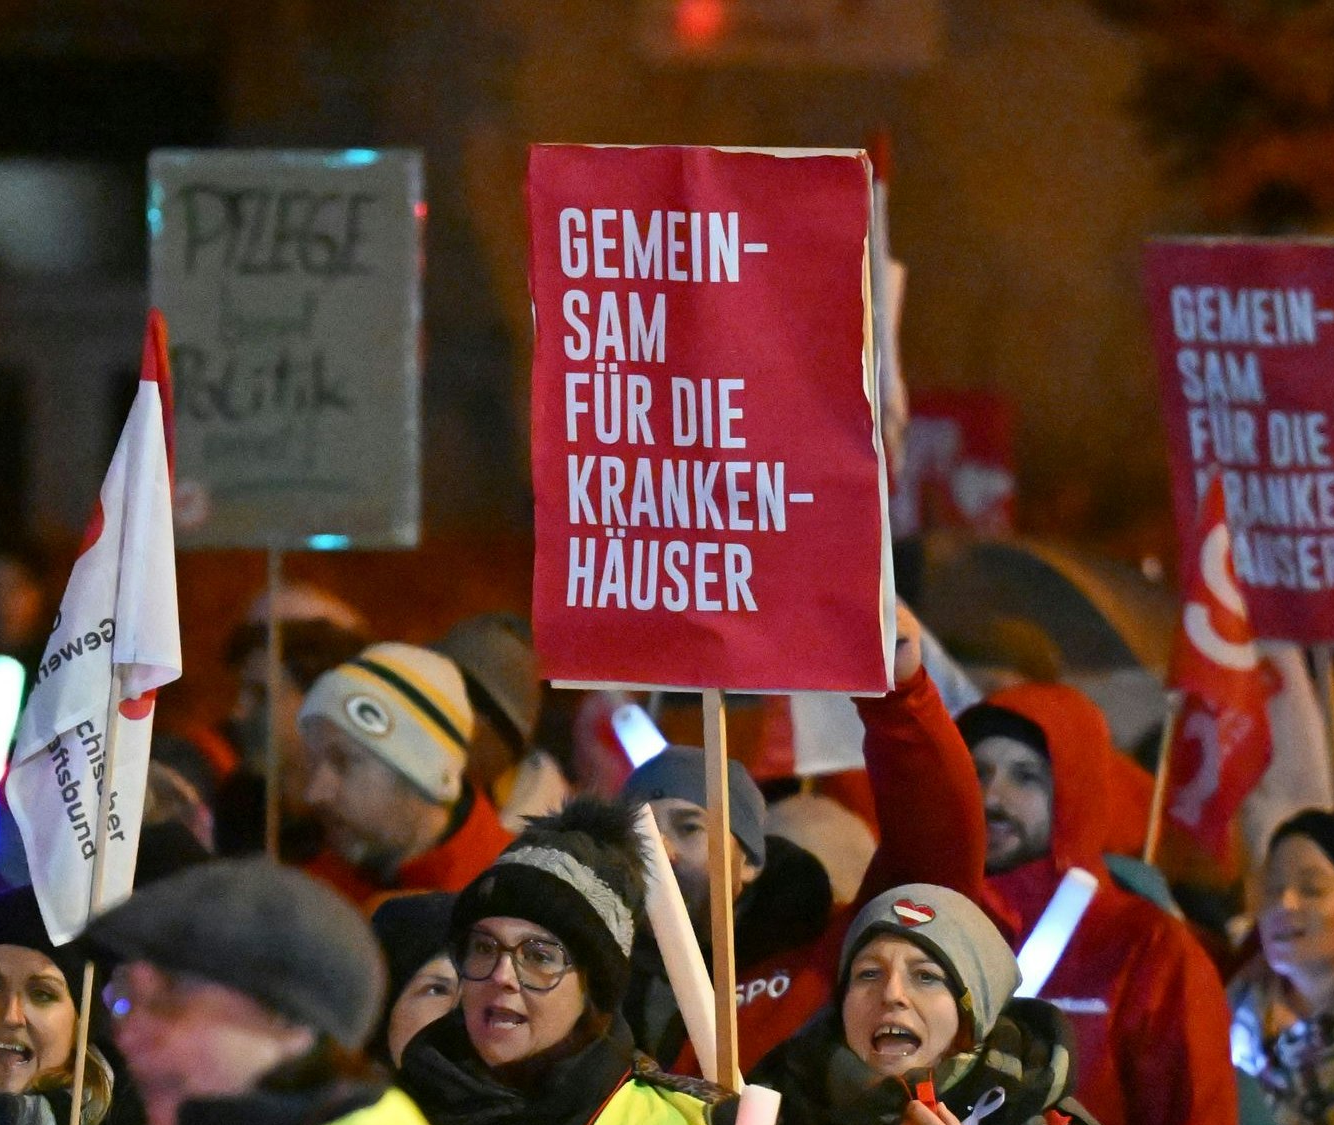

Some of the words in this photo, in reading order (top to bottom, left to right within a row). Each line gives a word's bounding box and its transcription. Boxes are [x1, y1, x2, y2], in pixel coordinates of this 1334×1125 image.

[559, 207, 768, 283] GEMEIN-
[563, 289, 666, 363] SAM
[565, 362, 655, 446] FÜR
[671, 376, 746, 449] DIE
[1176, 348, 1266, 405] SAM
[1267, 409, 1333, 469] DIE
[567, 454, 814, 532] KRANKEN-
[567, 528, 758, 611] HÄUSER
